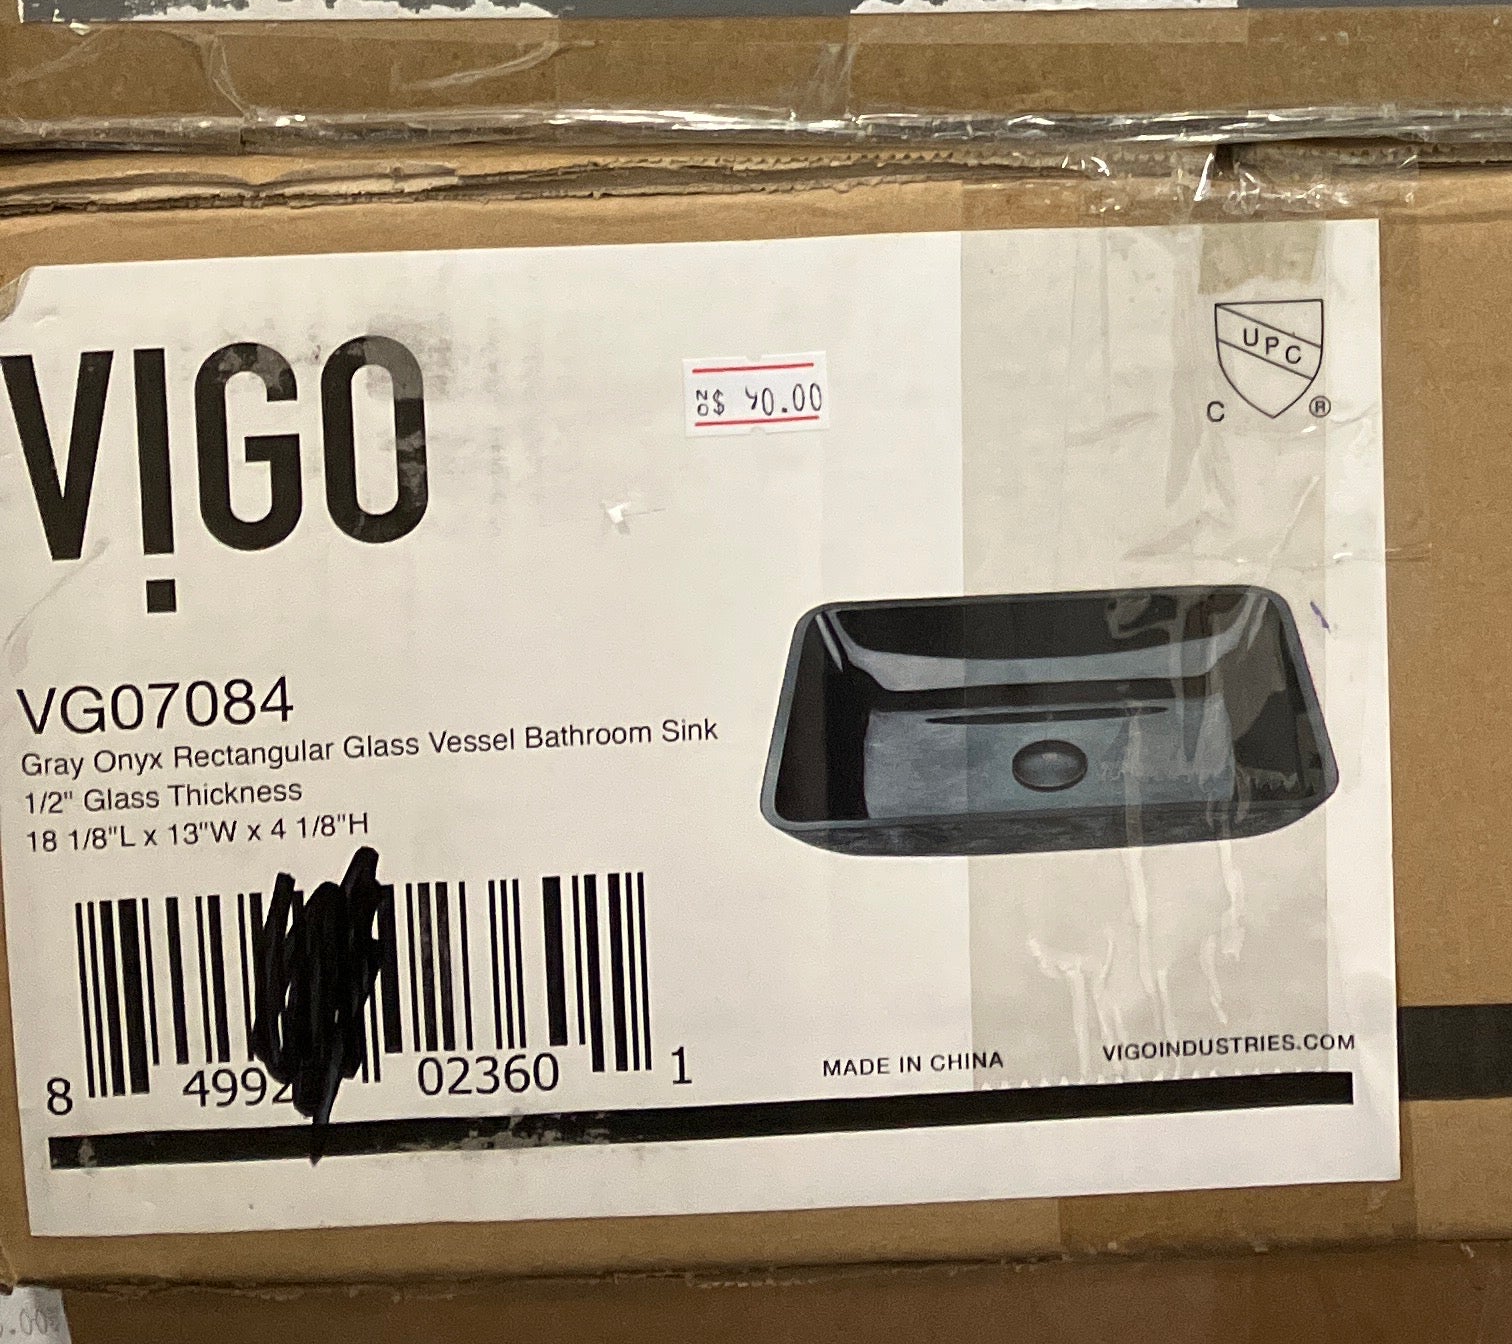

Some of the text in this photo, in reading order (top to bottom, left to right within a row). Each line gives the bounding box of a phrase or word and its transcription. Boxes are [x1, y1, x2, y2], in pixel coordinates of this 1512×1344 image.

[1243, 327, 1302, 365] UPC
[16, 676, 294, 735] VG07084
[21, 717, 718, 780] Gray Onyx Rectangular Glass Vessel Bathroom Sink
[25, 782, 302, 815] 1/2" Glass Thickness
[27, 830, 57, 853] 18
[143, 829, 157, 846] x
[168, 819, 237, 846] 13"W
[247, 825, 261, 841] x
[271, 818, 287, 840] 4
[821, 1049, 1004, 1078] MADE IN CHINA
[1101, 1033, 1356, 1063] VIGOINDUSTRIES.COM
[46, 1046, 693, 1115] 8 02360 1
